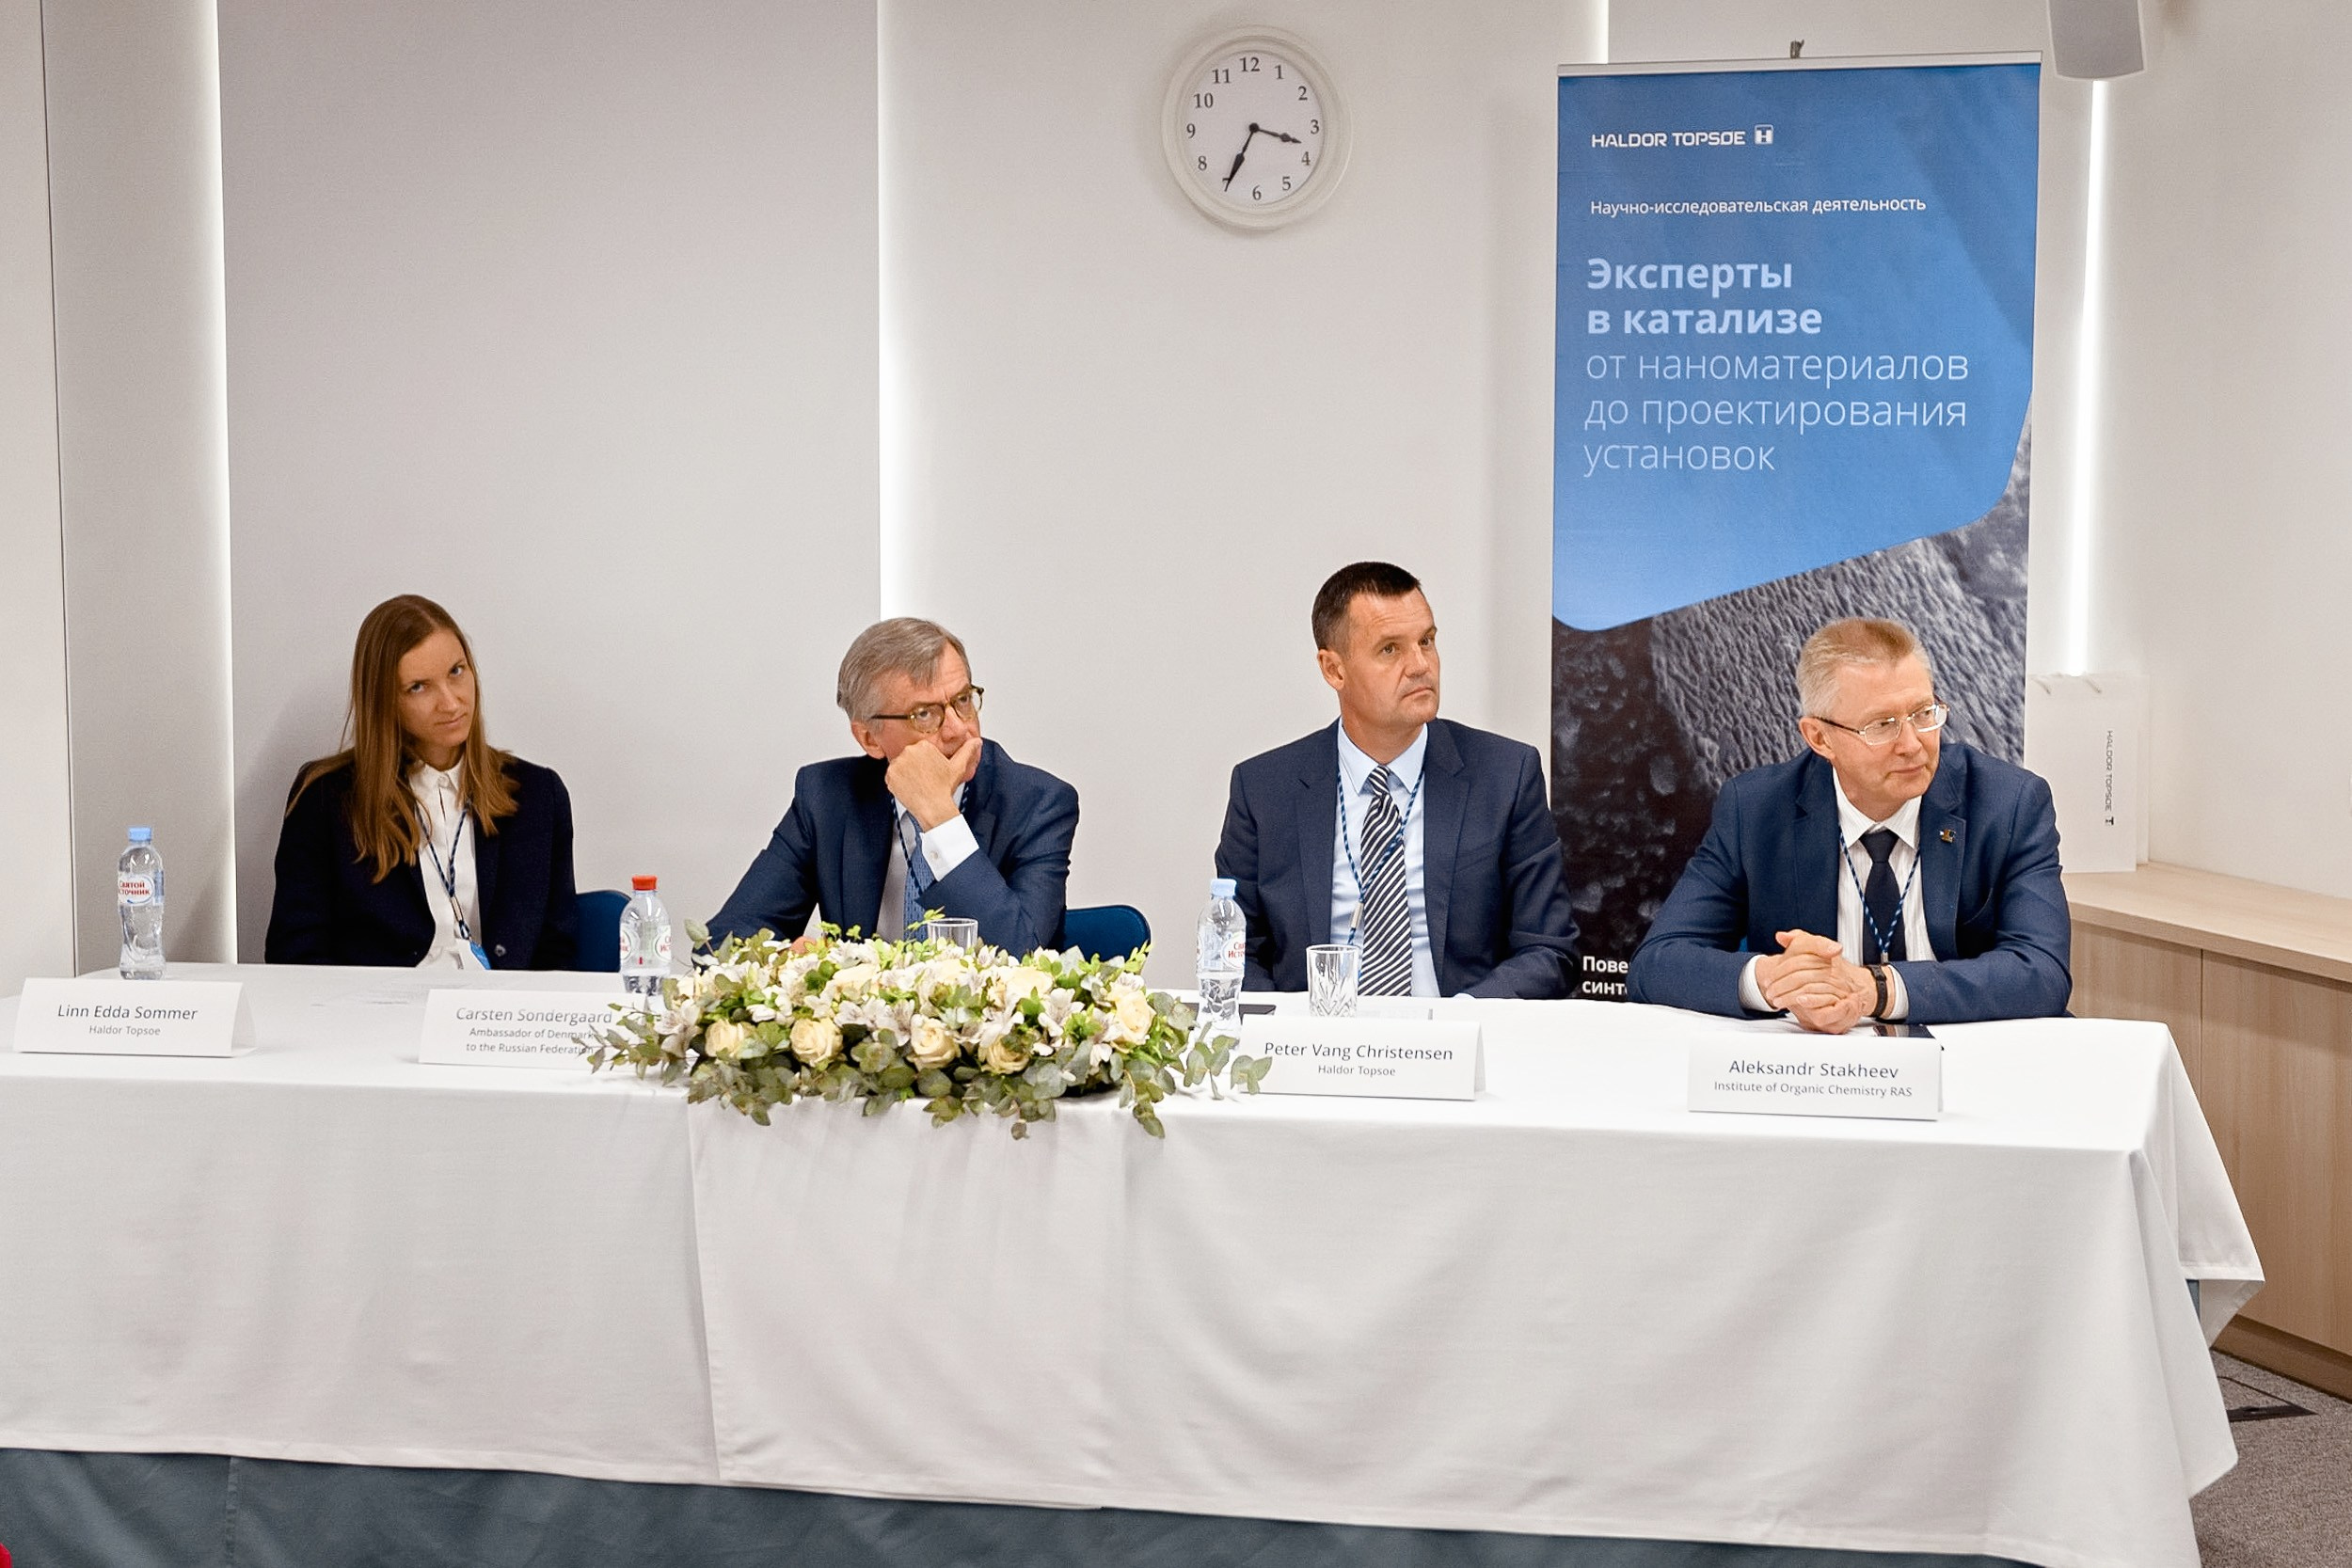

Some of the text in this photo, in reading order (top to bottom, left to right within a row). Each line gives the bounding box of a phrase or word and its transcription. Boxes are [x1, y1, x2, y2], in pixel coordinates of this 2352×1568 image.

[1240, 56, 1261, 72] 12
[1274, 65, 1284, 79] 1
[1212, 69, 1231, 84] 11
[1194, 93, 1214, 108] 10
[1298, 86, 1308, 101] 2
[1186, 123, 1196, 138] 9
[1310, 119, 1320, 135] 3
[1592, 132, 1667, 148] HALDOR
[1198, 155, 1207, 170] 8
[1301, 151, 1311, 166] 4
[1282, 176, 1292, 191] 5
[1252, 185, 1262, 200] 6
[1590, 198, 1927, 217] Научно-исследовательская деятельность
[1587, 258, 1792, 298] Эксперты
[1587, 307, 1822, 334] в катализе
[1586, 354, 1968, 388] от наноматериалов
[1584, 400, 1966, 435] до проектирования
[1582, 444, 1775, 478] установок
[2106, 730, 2114, 771] HALDOR
[1581, 980, 1628, 995] синт
[57, 1004, 199, 1020] Linn Edda Sommer
[456, 1007, 612, 1026] Carsten Sondergaard
[89, 1025, 161, 1037] Haldor Topsoe
[469, 1026, 595, 1039] Ambassador of Denmark
[466, 1043, 477, 1052] to
[479, 1042, 496, 1052] the
[499, 1043, 537, 1053] Russian
[1263, 1042, 1454, 1061] Peter Vang Christensen
[1318, 1065, 1396, 1078] Haldor Topsoe
[1728, 1060, 1899, 1079] Aleksandr Stakheev
[1714, 1081, 1913, 1099] Institute of Organic Chemistry RAS
